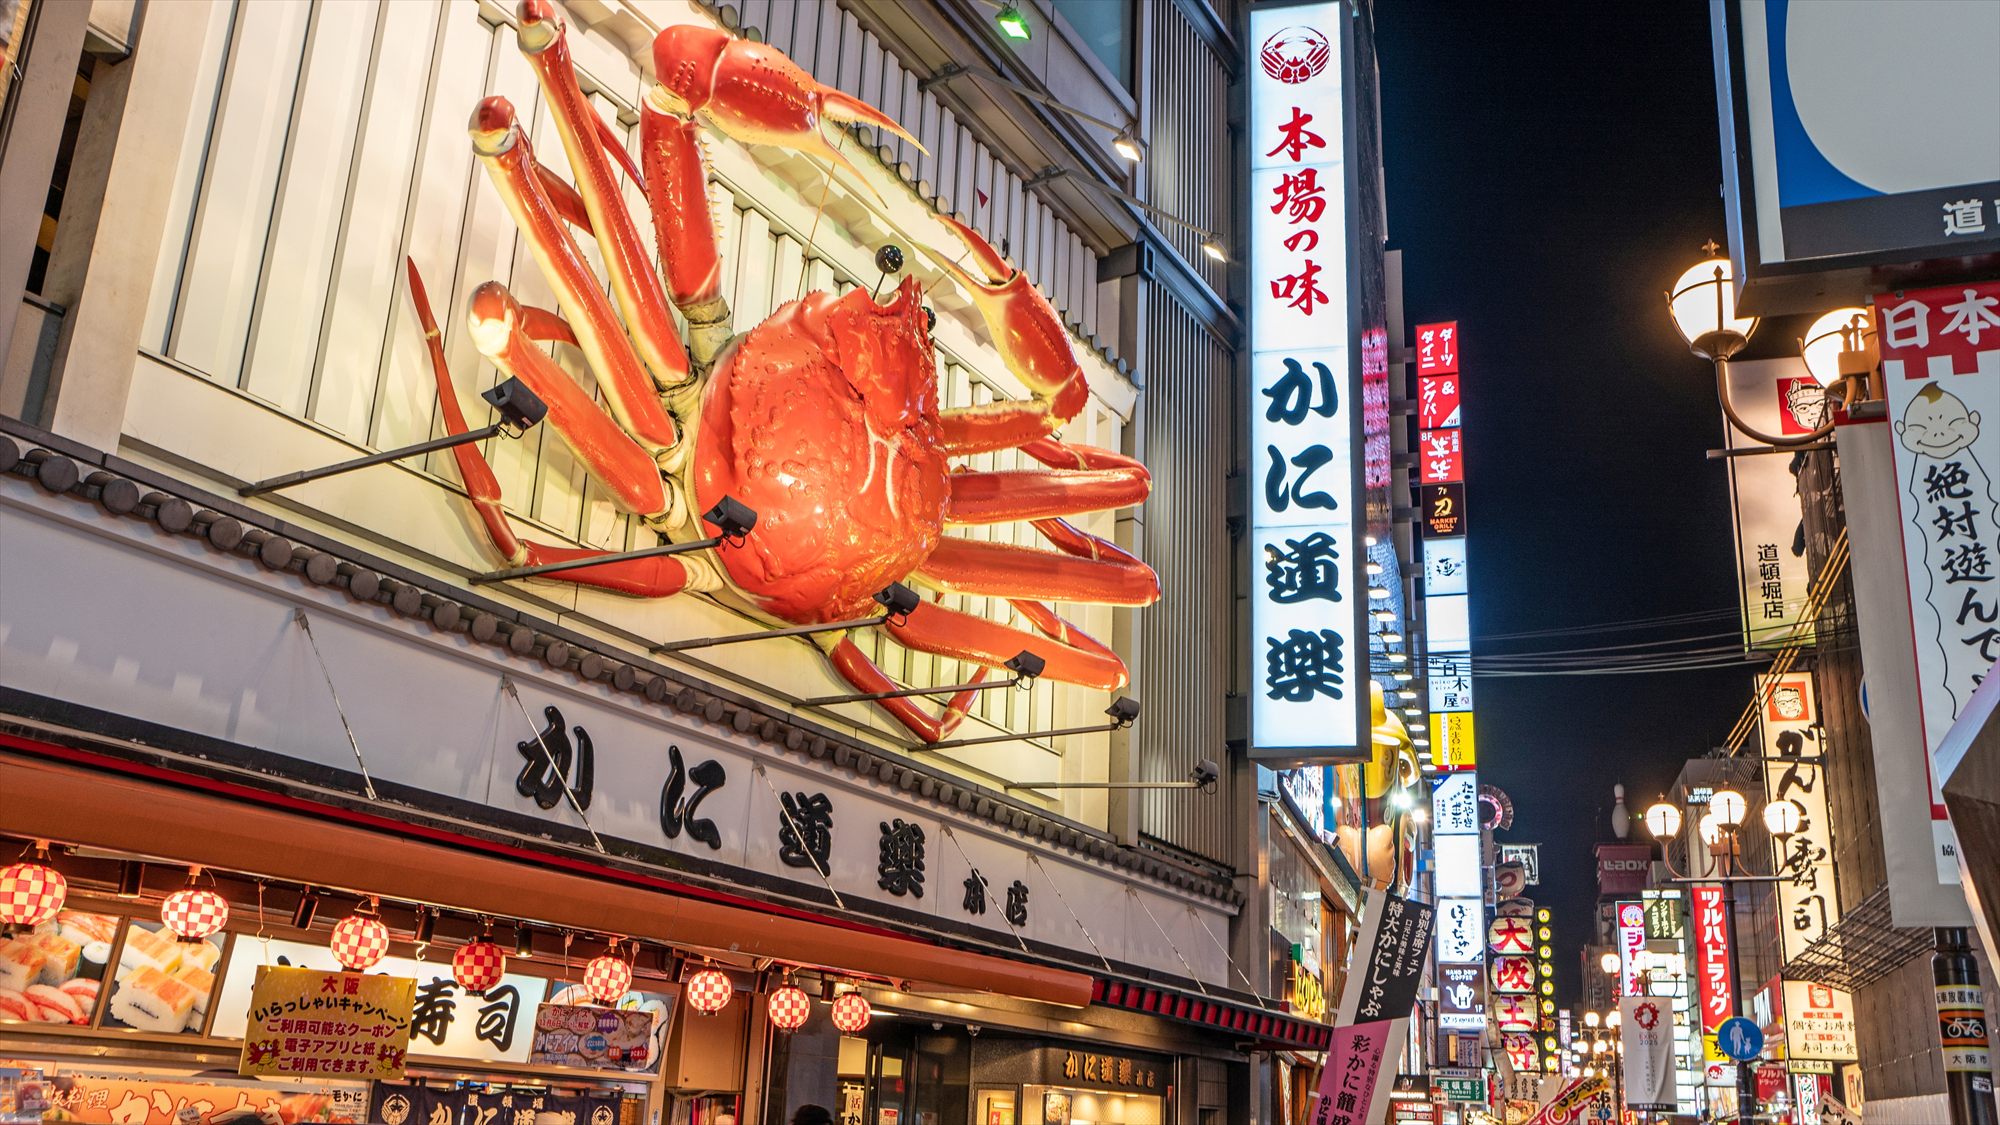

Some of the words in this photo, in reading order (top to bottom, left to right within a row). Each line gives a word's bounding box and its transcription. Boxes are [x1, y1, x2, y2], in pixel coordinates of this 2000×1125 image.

[1266, 106, 1329, 317] 本場の味
[1942, 198, 2000, 237] 道
[1421, 432, 1432, 441] 8F
[1429, 517, 1458, 525] MARKET
[1757, 543, 1784, 619] 道頓堀店
[1443, 659, 1469, 707] 白木屋
[1406, 908, 1432, 976] 特別会席フェア
[1360, 901, 1404, 1017] 特大かにしゃぶ
[1700, 891, 1730, 1016] ツルハドラッグ
[320, 975, 360, 995] 大阪
[1488, 917, 1535, 1070] 大阪王将
[254, 996, 409, 1031] いらっしゃいキャンペーン
[1475, 1004, 1483, 1013] 1F
[266, 1018, 396, 1039] ご利用可能なクーポン
[284, 1037, 376, 1056] 電子アプリと紙
[277, 1056, 375, 1075] ご利用できます。
[1952, 1054, 1988, 1065] 大阪市
[1758, 1069, 1785, 1079] ツルハ
[332, 1089, 363, 1102] 毛かに
